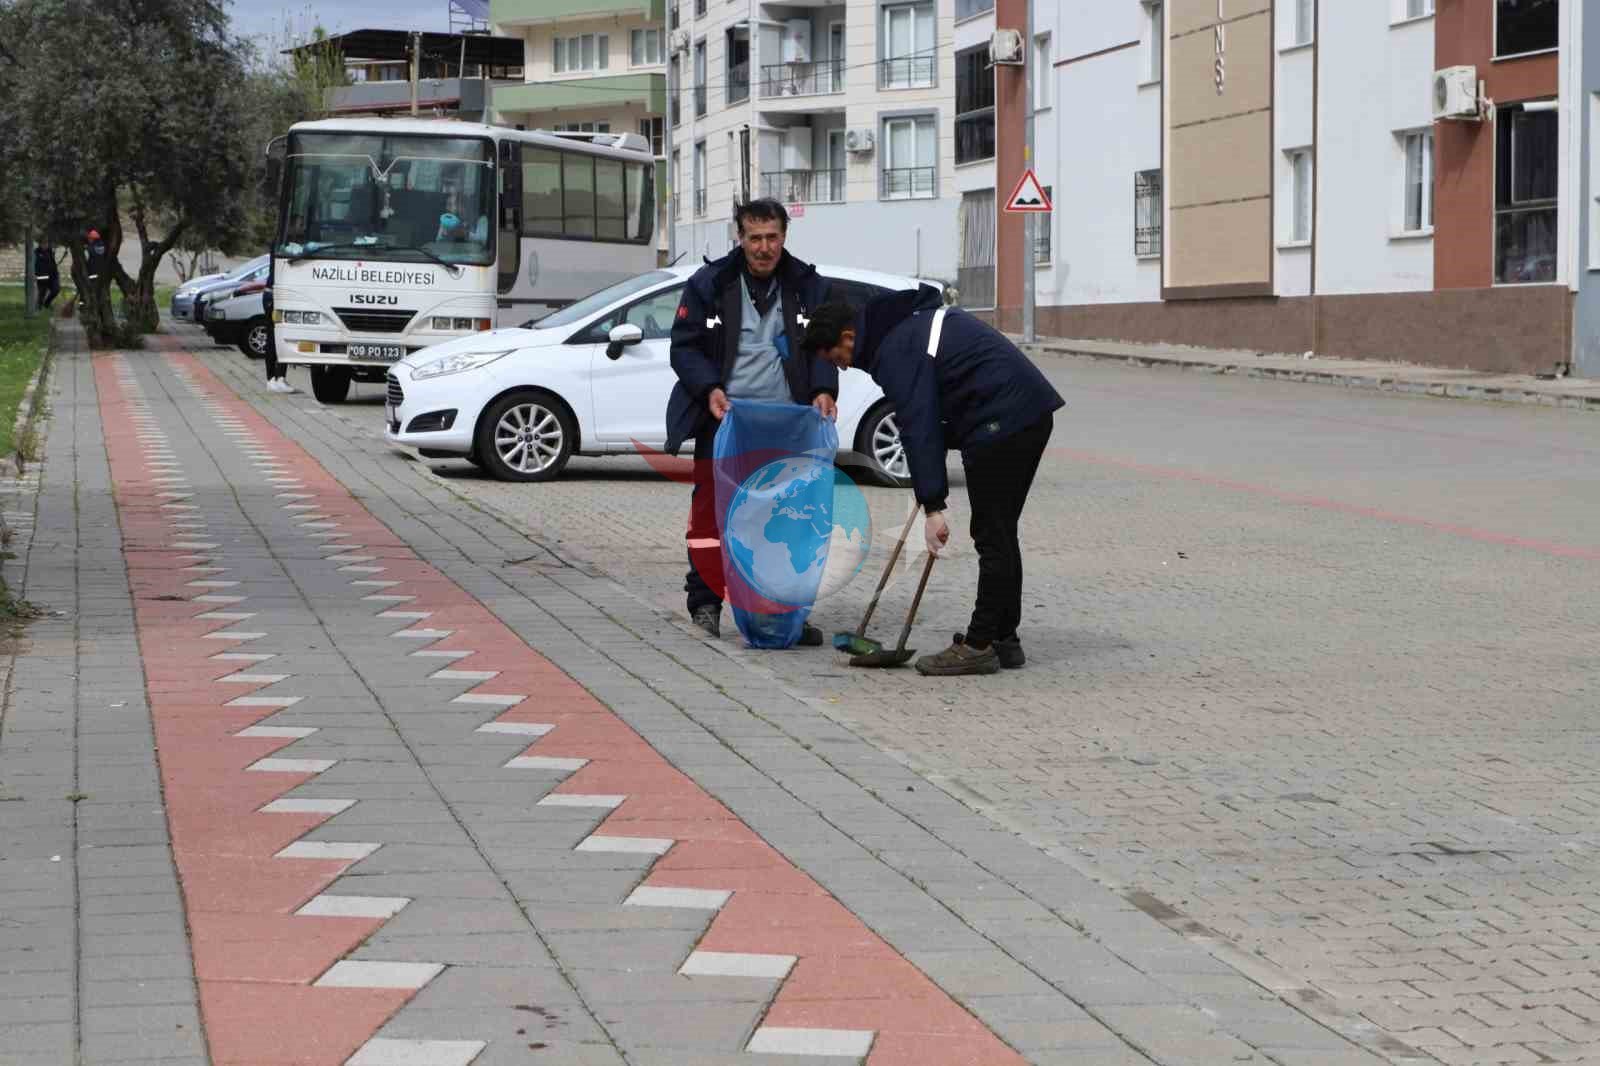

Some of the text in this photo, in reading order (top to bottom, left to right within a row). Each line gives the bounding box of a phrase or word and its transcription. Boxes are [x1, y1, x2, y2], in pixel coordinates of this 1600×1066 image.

[312, 266, 435, 285] NAZİLLİ BELEDİYESİ
[350, 294, 398, 305] ISUZU
[383, 347, 399, 358] 123
